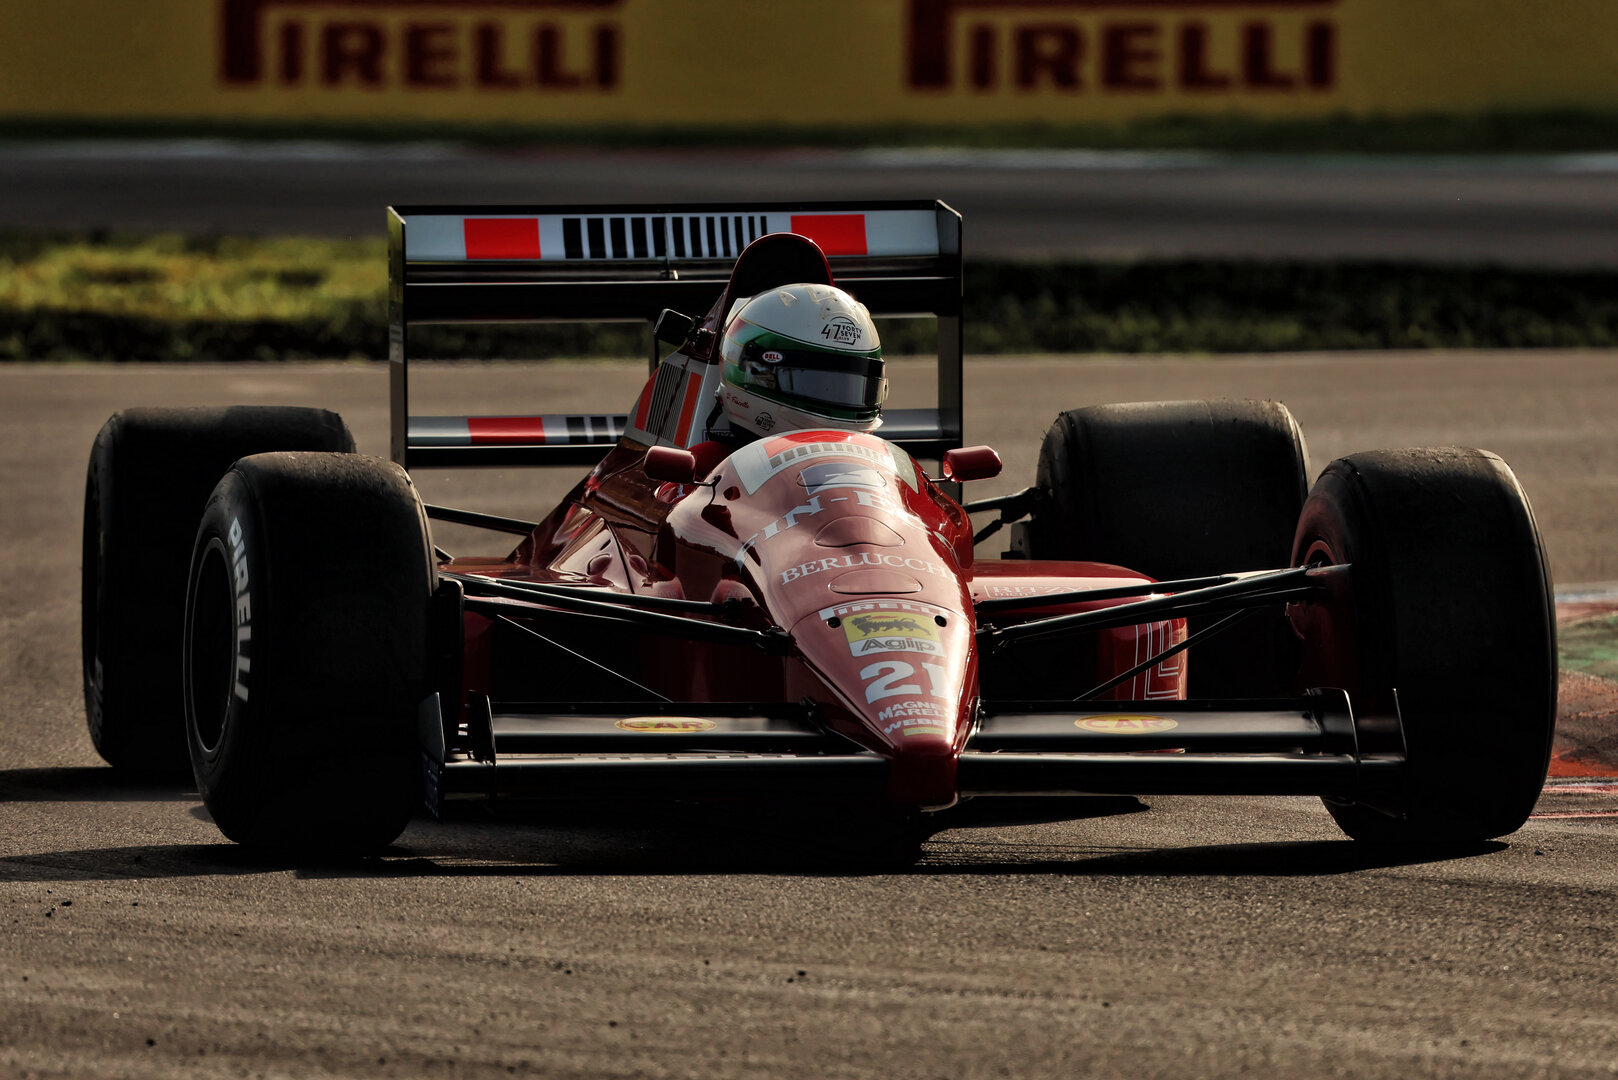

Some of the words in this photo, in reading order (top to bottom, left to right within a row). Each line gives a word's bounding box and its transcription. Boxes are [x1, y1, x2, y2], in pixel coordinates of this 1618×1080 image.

[215, 0, 624, 91] PIRELLI
[904, 0, 1342, 91] PIRELLI
[821, 324, 841, 339] 47
[840, 331, 861, 339] SEVEN
[842, 325, 862, 334] FORTY
[780, 552, 958, 586] BERLUCCH
[227, 517, 252, 702] PIRELLI
[861, 637, 936, 652] Agip
[859, 660, 950, 705] 21
[883, 718, 947, 734] WEBE
